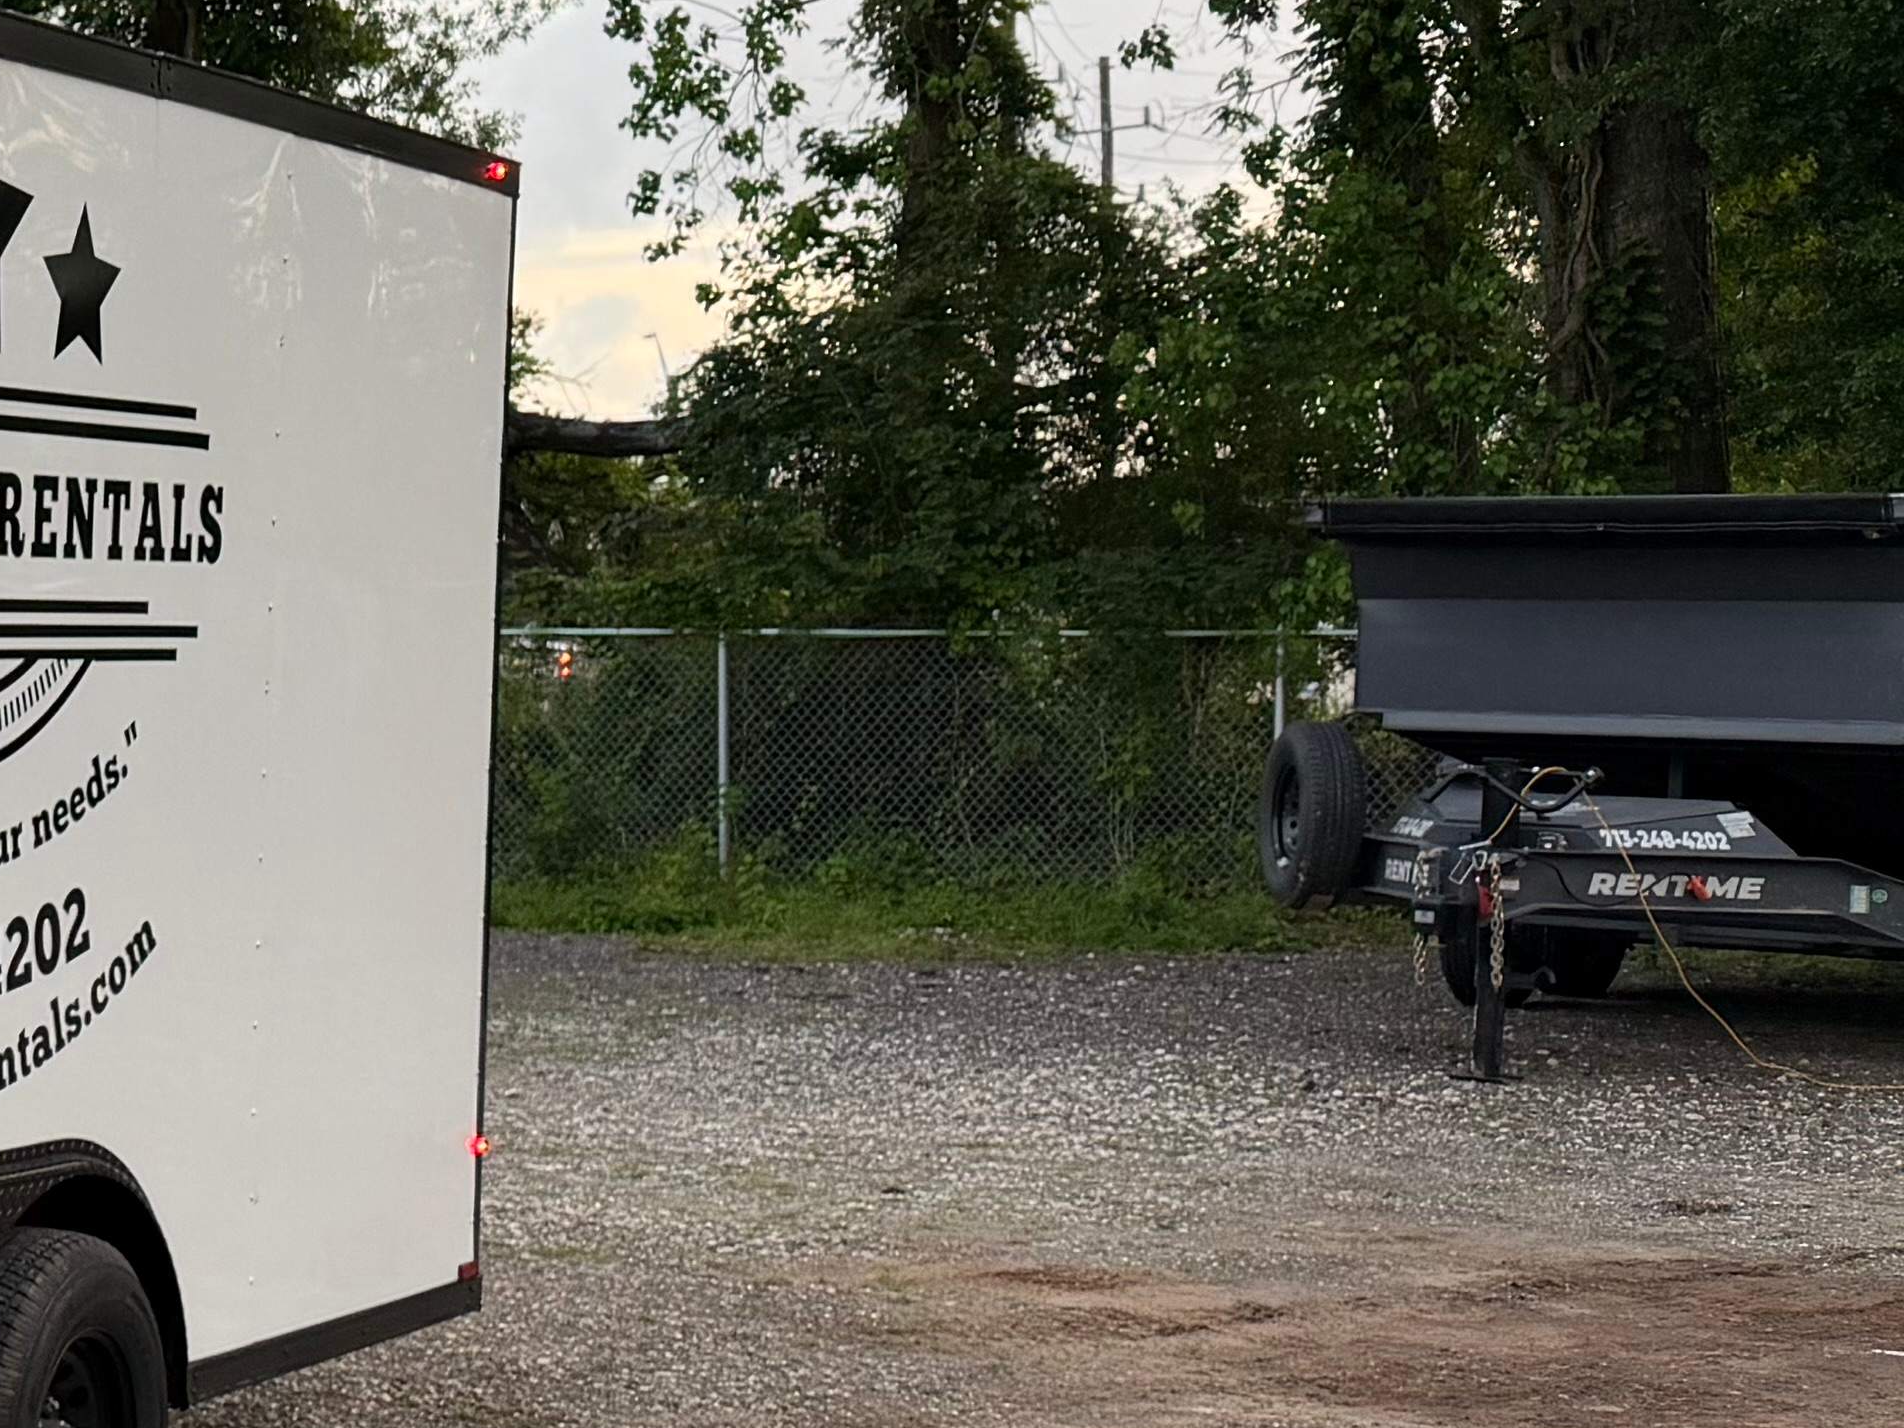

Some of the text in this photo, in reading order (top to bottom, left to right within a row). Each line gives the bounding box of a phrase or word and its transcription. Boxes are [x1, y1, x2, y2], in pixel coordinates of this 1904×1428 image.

[31, 720, 140, 850] needs."
[1598, 828, 1732, 851] 713-248-4202
[1587, 871, 1766, 901] RENT ME
